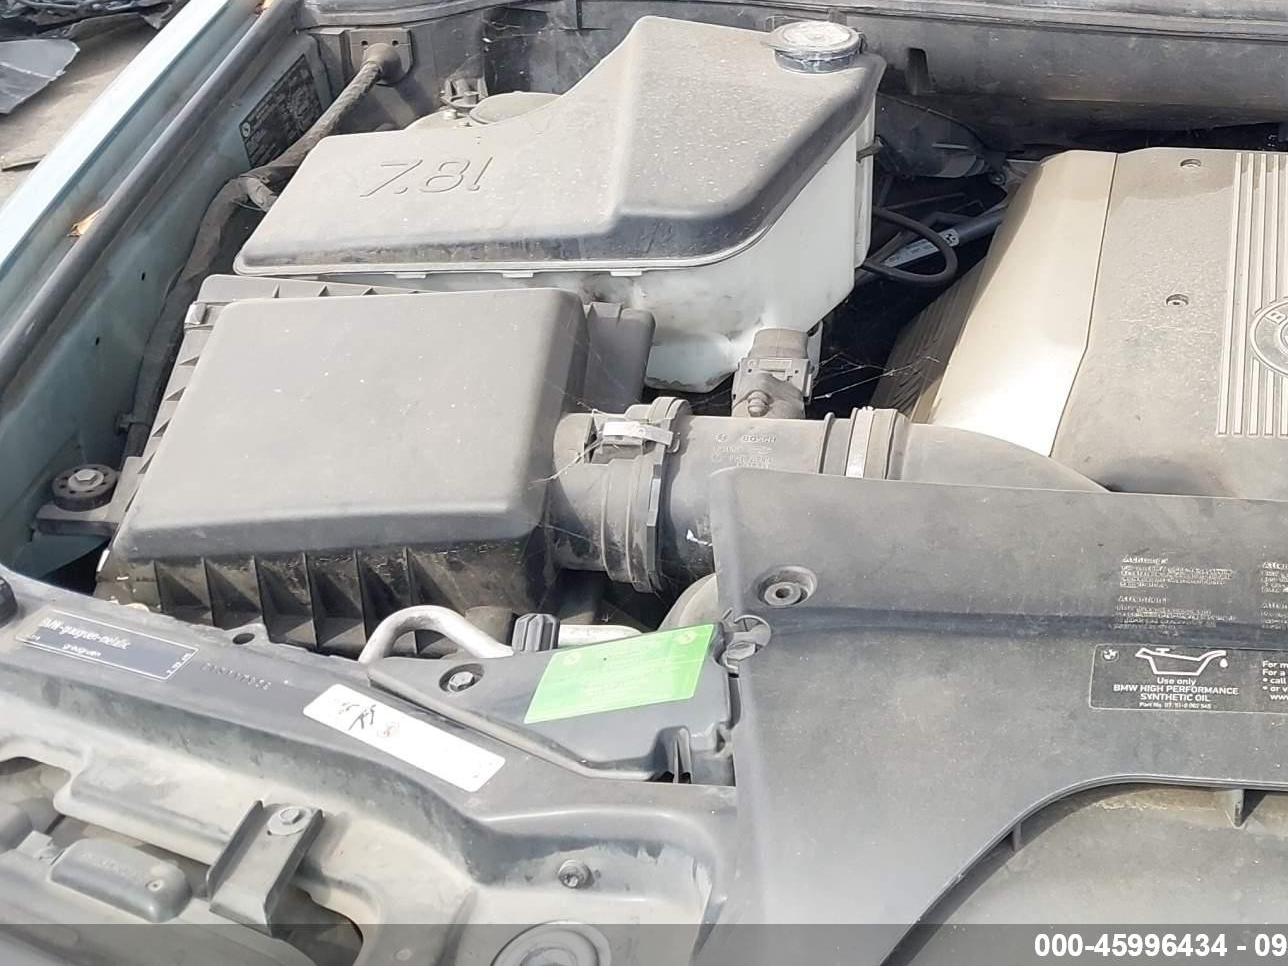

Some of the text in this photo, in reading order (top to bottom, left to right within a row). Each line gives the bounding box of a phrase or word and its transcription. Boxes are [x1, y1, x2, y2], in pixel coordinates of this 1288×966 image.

[1177, 678, 1196, 686] only
[1140, 684, 1164, 692] HIGH
[1166, 686, 1240, 694] PERFORMANCE
[1140, 694, 1193, 702] SYNTHETIC
